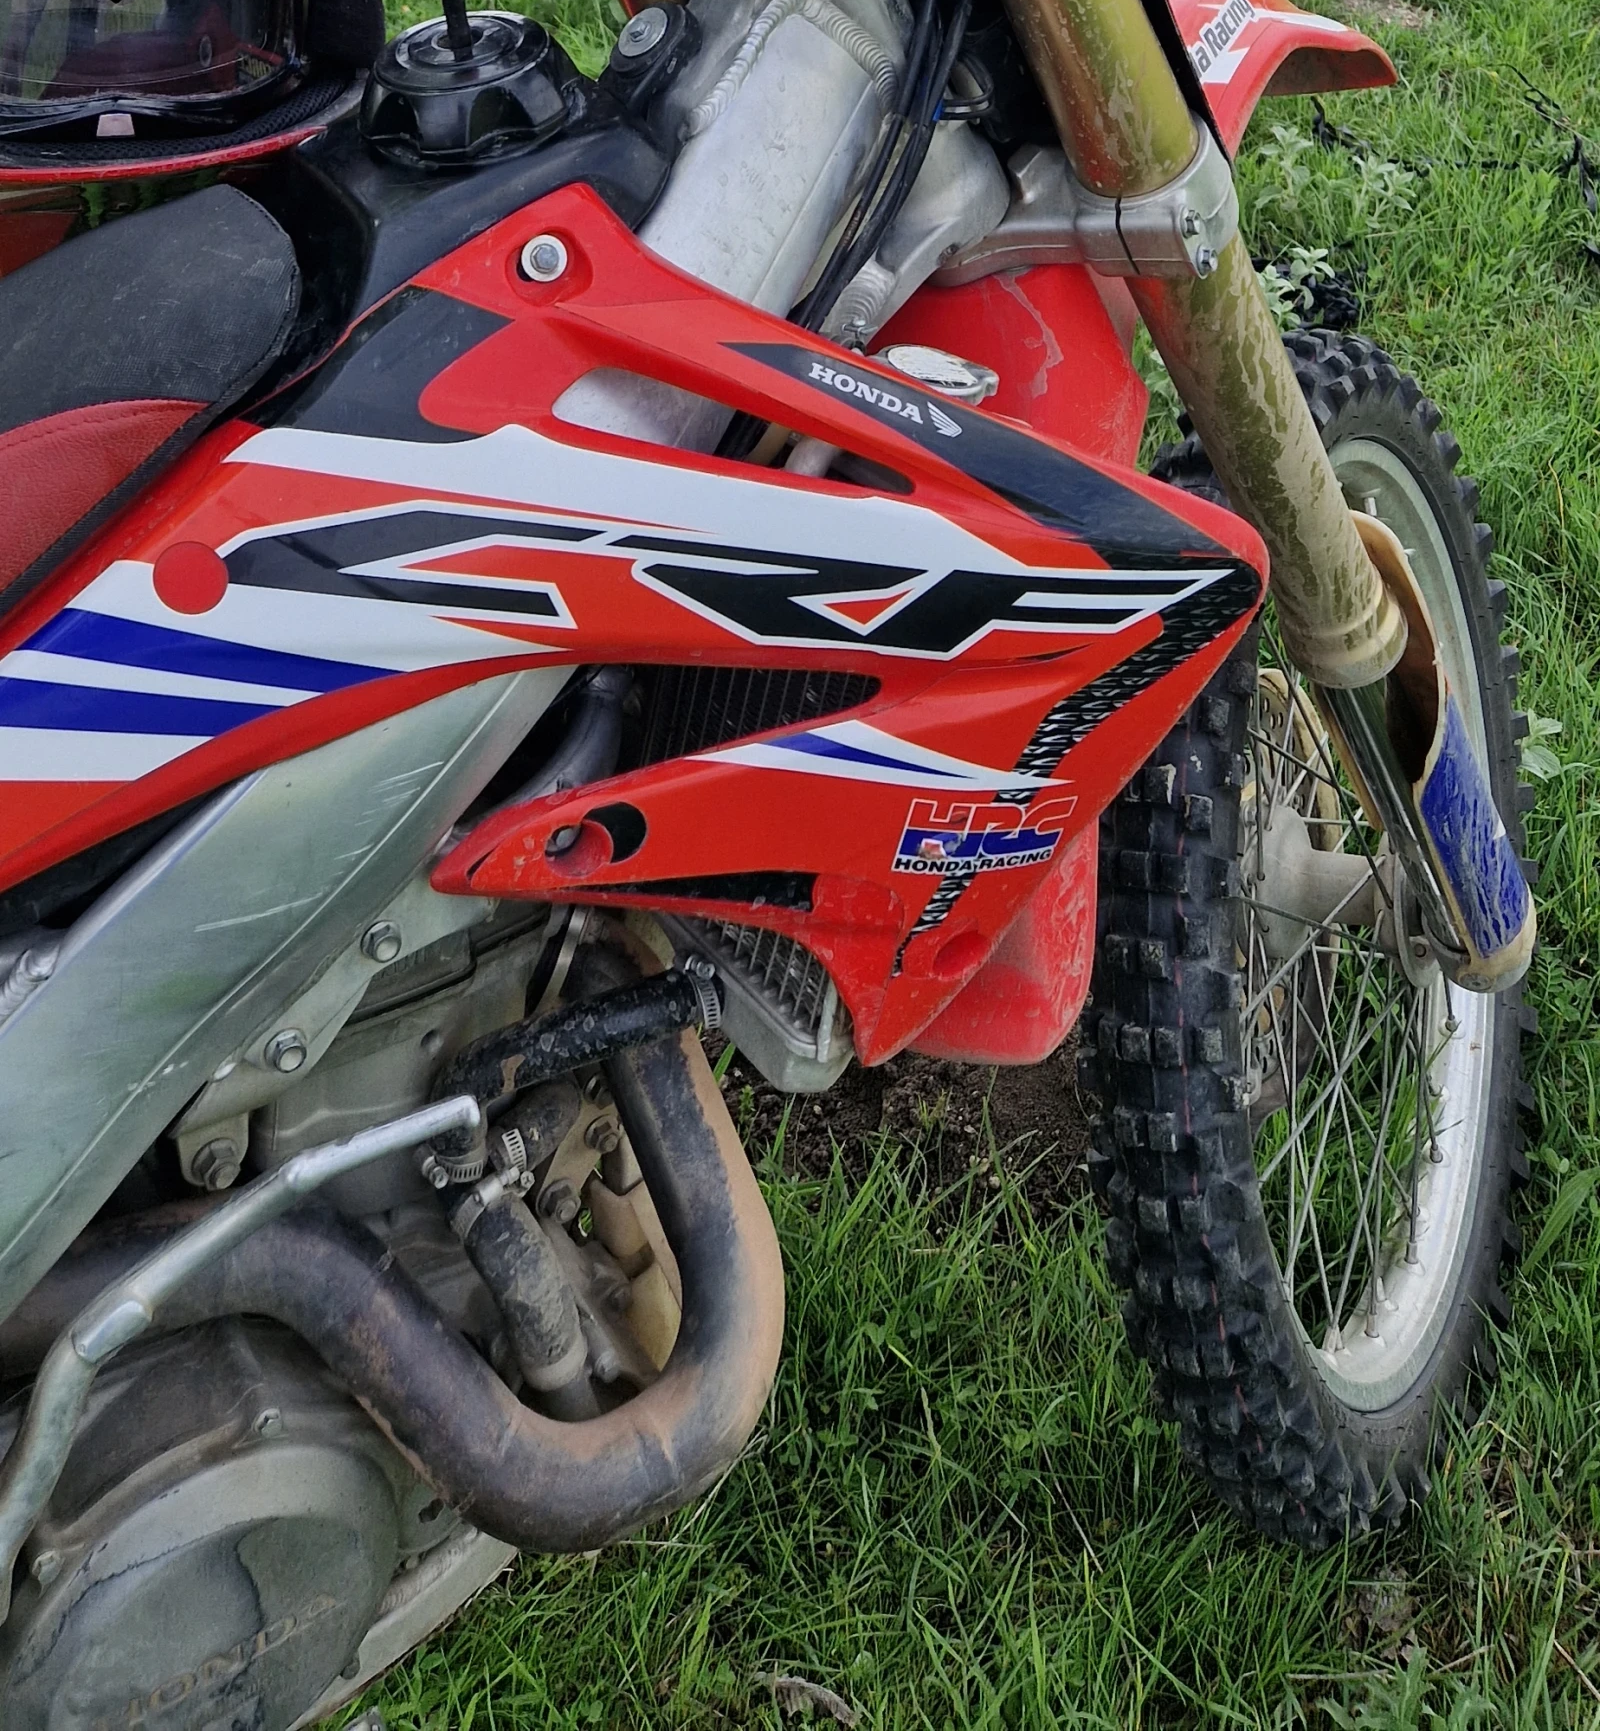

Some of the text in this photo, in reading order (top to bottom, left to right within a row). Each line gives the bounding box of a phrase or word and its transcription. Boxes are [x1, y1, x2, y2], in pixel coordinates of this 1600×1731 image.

[808, 361, 924, 425] HONDA
[220, 503, 1218, 659] CRF
[898, 798, 1078, 857] HRC
[893, 848, 1052, 873] HONDA RACING
